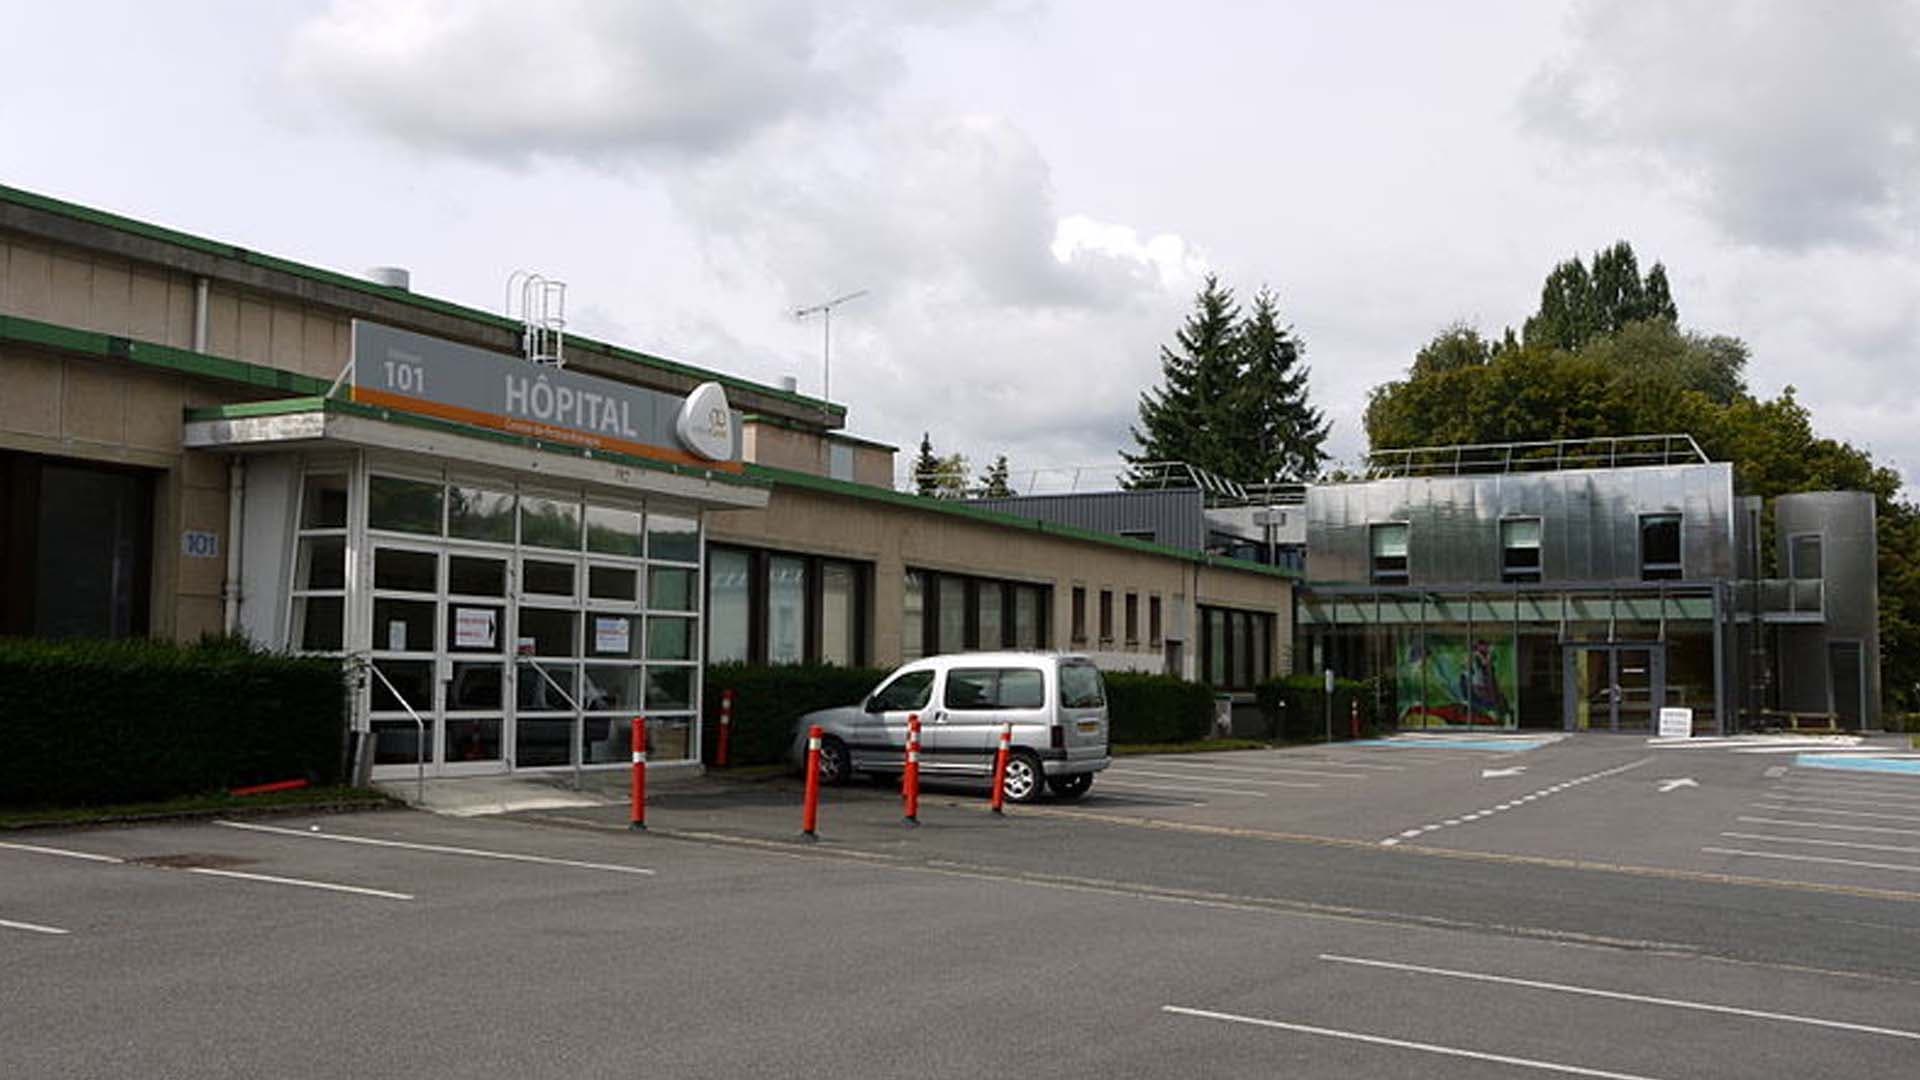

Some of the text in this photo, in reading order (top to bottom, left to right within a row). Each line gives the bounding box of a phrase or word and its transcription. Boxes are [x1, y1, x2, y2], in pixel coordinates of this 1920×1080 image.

[383, 361, 424, 393] 101
[504, 373, 638, 437] HÔPITAL
[186, 533, 216, 555] 101
